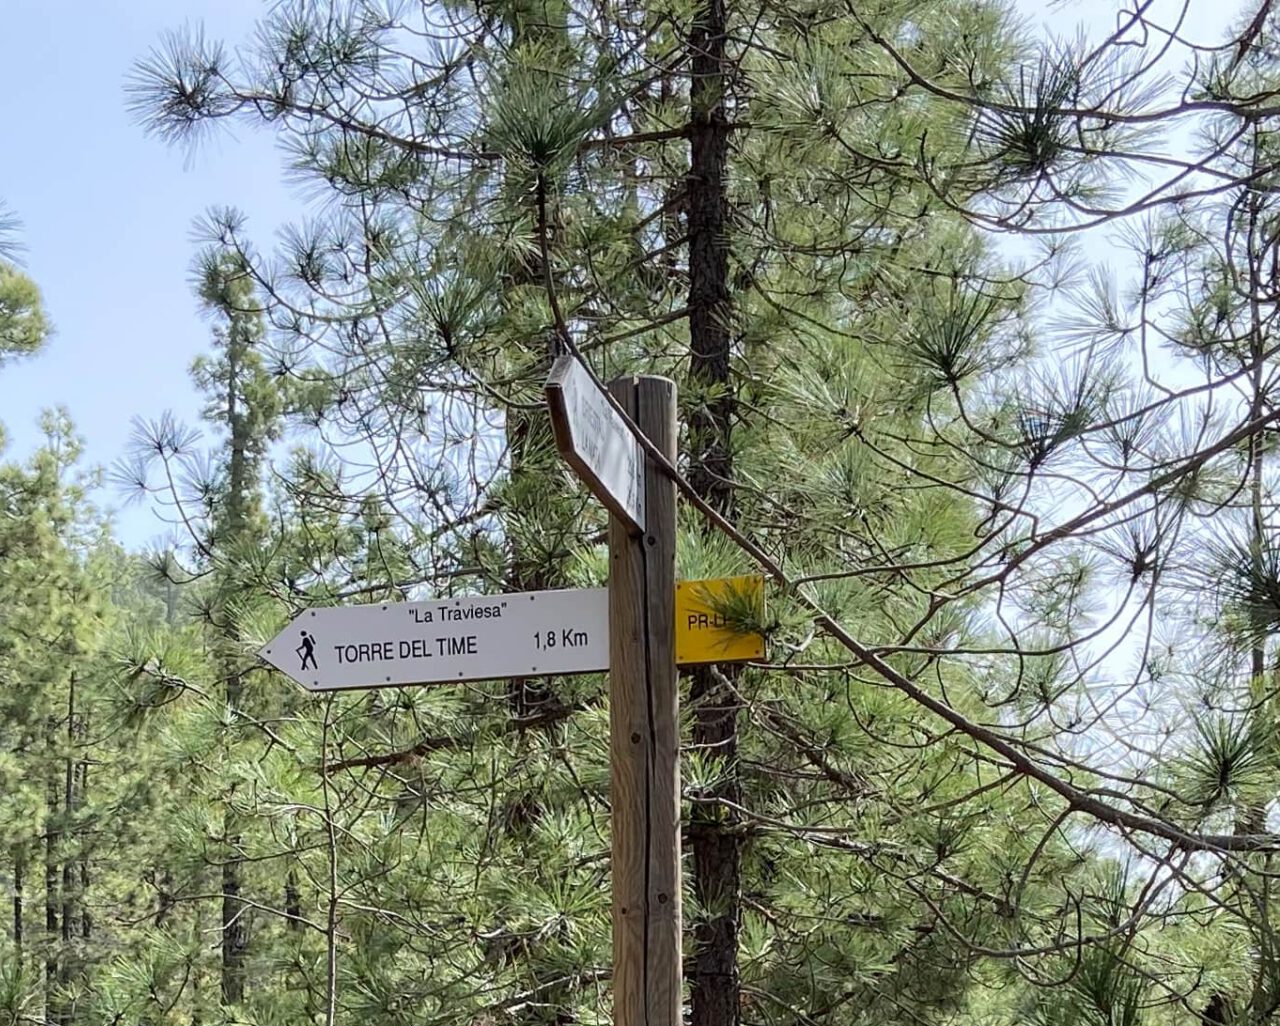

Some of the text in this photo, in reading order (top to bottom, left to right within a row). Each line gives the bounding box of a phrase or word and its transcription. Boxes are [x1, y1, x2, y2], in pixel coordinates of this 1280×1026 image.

[409, 602, 507, 623] "La Traviesa"
[334, 628, 589, 664] TORRE DEL TIME 1,8 Km
